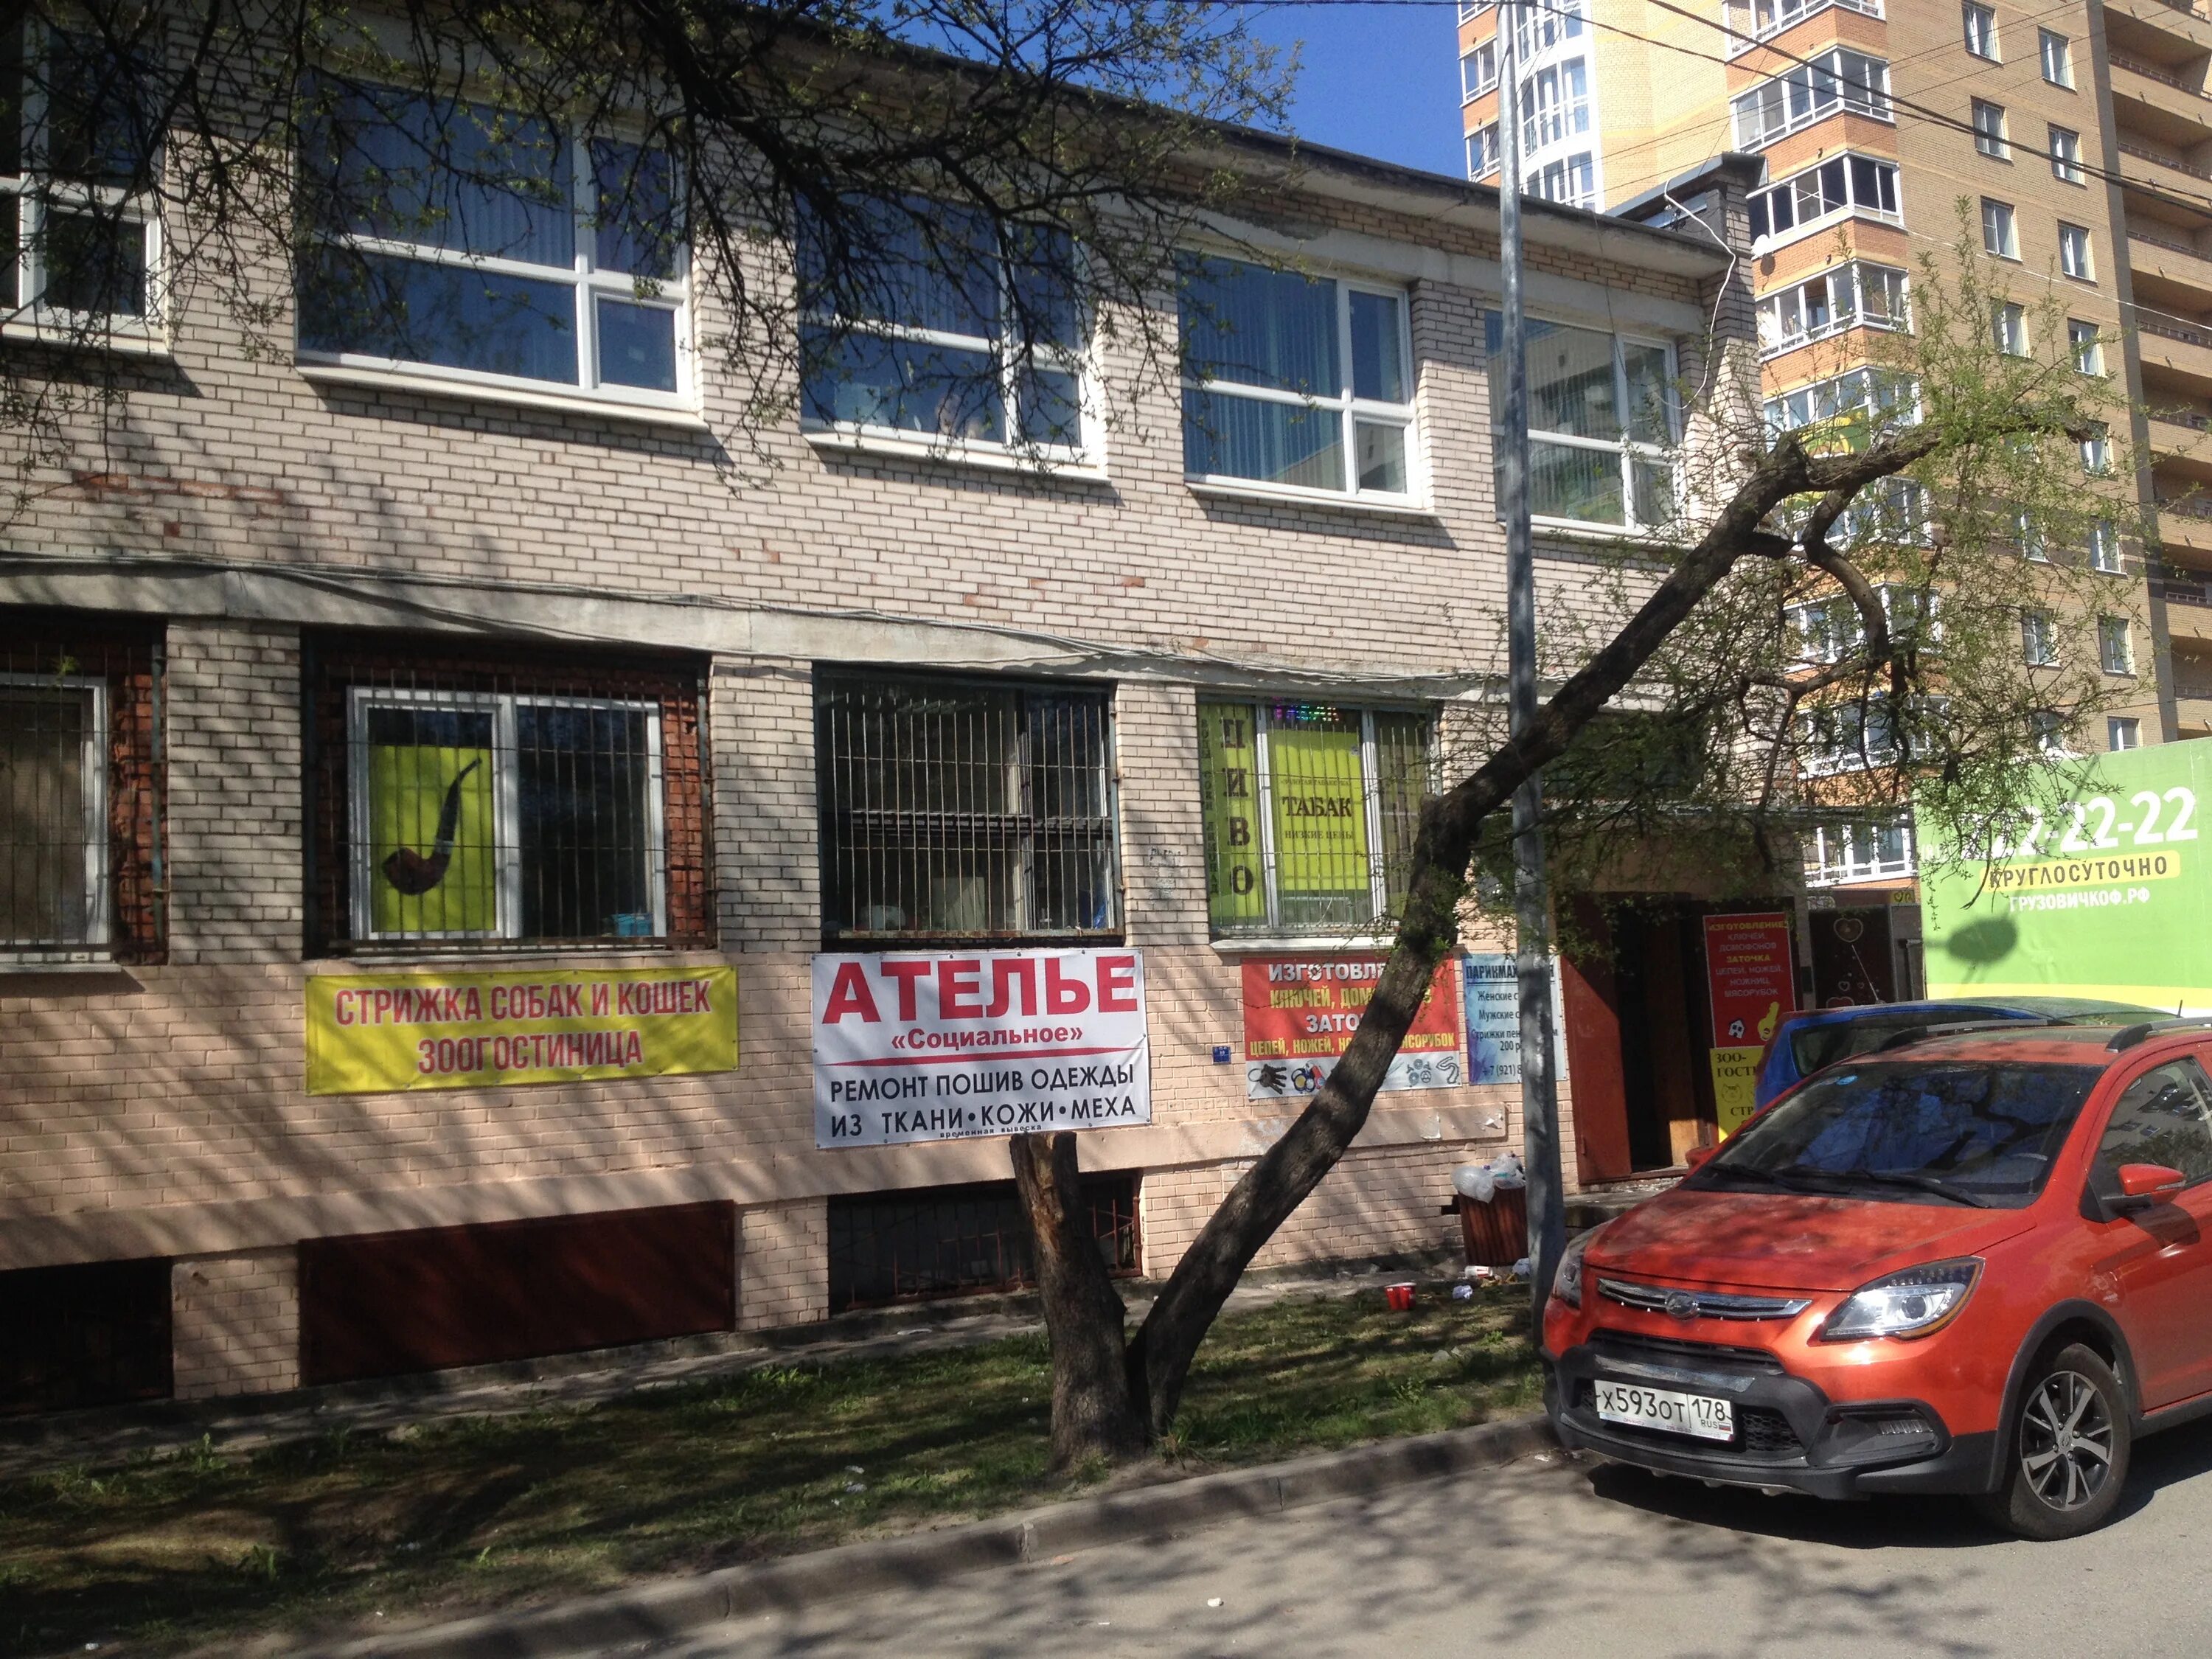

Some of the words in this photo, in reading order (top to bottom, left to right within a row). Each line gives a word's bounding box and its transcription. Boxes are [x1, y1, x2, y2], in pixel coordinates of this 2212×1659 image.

[1220, 719, 1254, 895] ПИВО
[1282, 796, 1352, 817] ТАБАК
[1285, 831, 1323, 839] НИЗКИЕ
[1989, 856, 2168, 890] КРУГЛОСУТОЧНО
[2009, 887, 2151, 912] ГРУЗОВИЧКОФ.РФ
[1719, 942, 1777, 953] ДОМОФОНОВ
[1725, 954, 1770, 963] ЗАТОЧКА
[822, 956, 1138, 1024] АТЕЛЬЕ
[1270, 985, 1335, 1009] КЛЮЧЕЙ,
[1478, 991, 1512, 1001] Женские
[1724, 988, 1778, 998] МЯСОРУБОК
[336, 986, 481, 1025] СТРИЖКА
[490, 984, 583, 1020] СОБАК
[591, 982, 609, 1017] И
[617, 980, 712, 1015] КОШЕК
[1306, 1012, 1365, 1033] ЗАТО
[1479, 1010, 1514, 1022] Мужские
[891, 1026, 1083, 1051] «Социальное»
[1472, 1029, 1504, 1041] Стрижки
[418, 1030, 642, 1074] ЗООГОСТИНИЦА
[1250, 1038, 1289, 1057] ЦЕПЕЙ,
[1293, 1037, 1335, 1054] НОЖЕЙ,
[1500, 1041, 1514, 1051] 200
[1717, 1052, 1747, 1062] ЗОО-
[1496, 1064, 1516, 1077] (921)
[830, 1075, 928, 1102] РЕМОНТ
[936, 1070, 1023, 1096] ПОШИВ
[1031, 1064, 1133, 1091] ОДЕЖДЫ
[831, 1114, 862, 1137] ИЗ
[1071, 1096, 1136, 1120] МЕХА
[939, 1128, 995, 1138] временная
[1001, 1124, 1042, 1133] вывеска
[1691, 1398, 1725, 1421] 178
[1700, 1419, 1719, 1429] RUS
